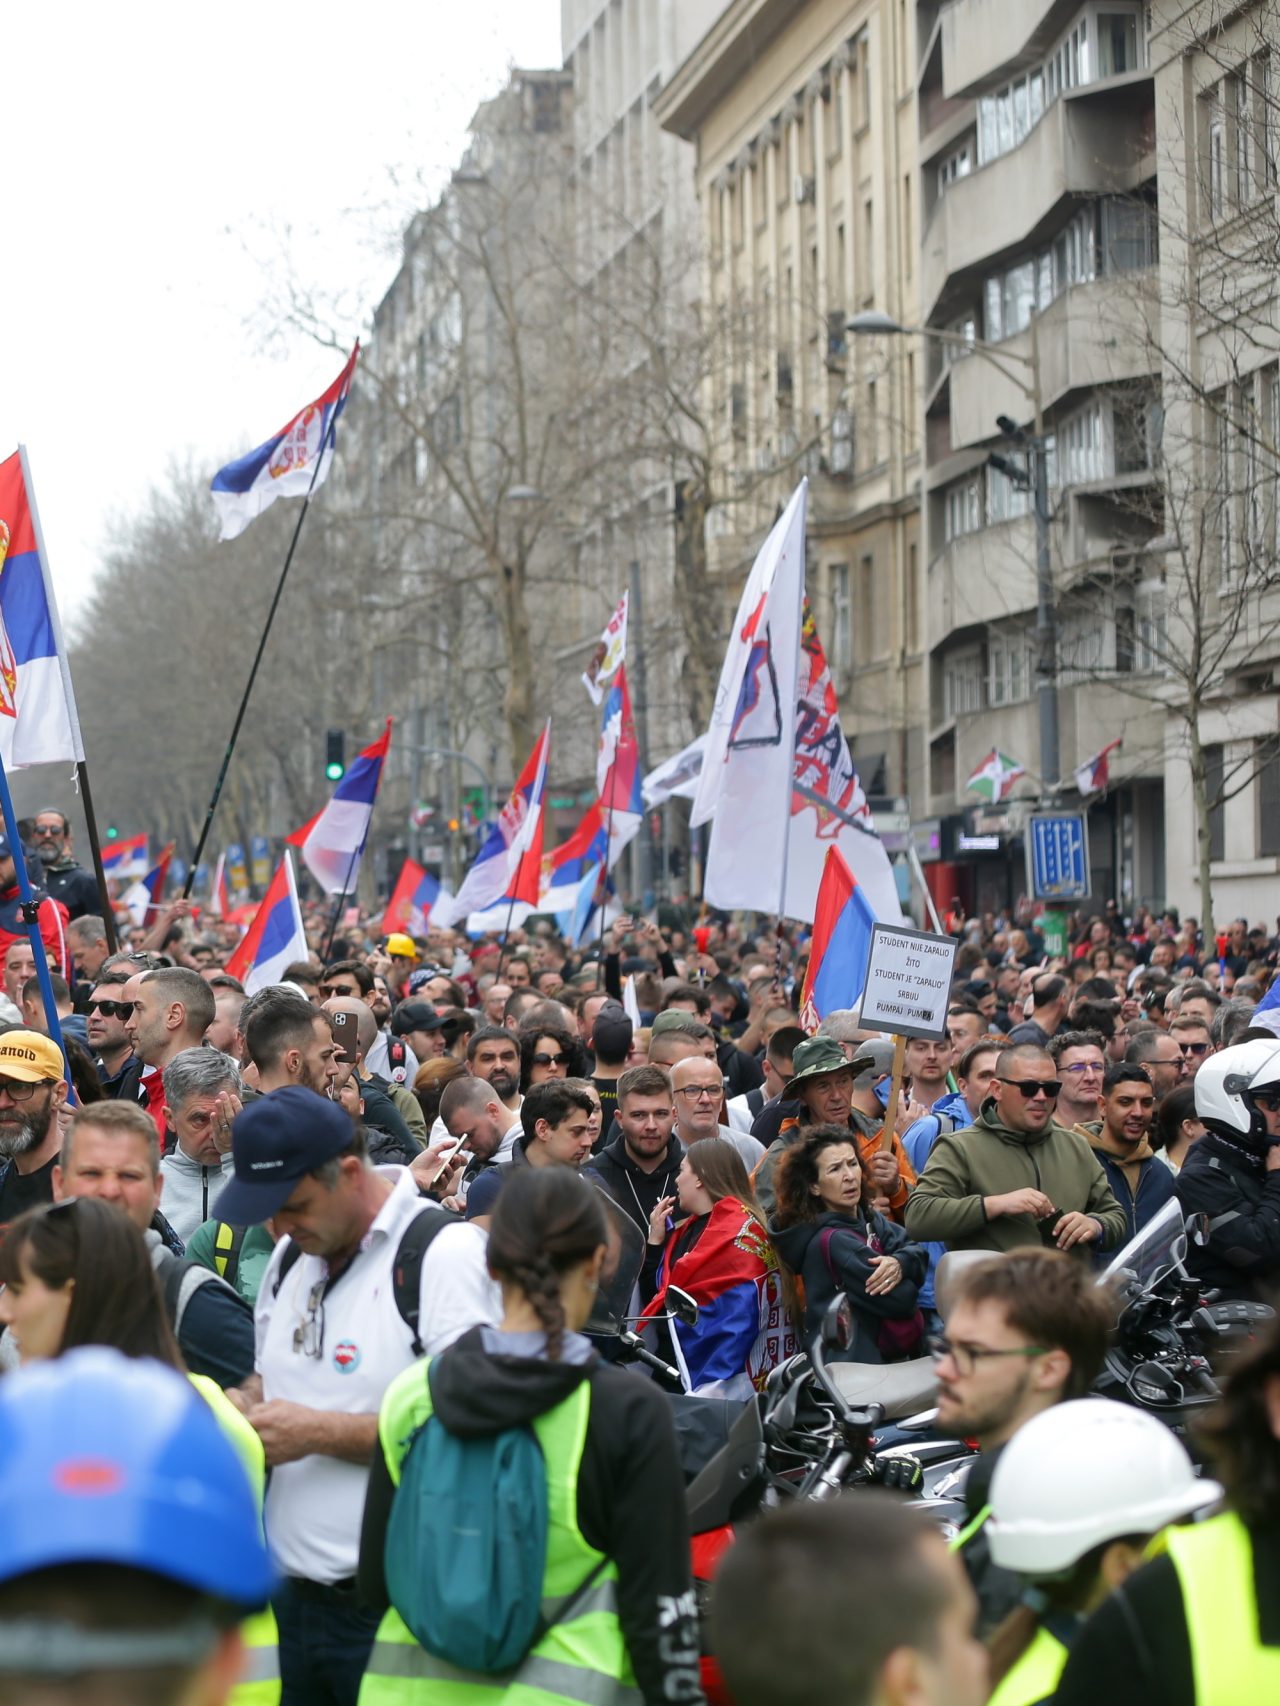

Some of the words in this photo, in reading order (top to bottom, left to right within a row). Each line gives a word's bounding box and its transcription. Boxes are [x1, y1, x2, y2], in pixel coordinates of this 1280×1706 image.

[879, 936, 908, 950] STUDENT
[910, 941, 924, 952] NIJE
[924, 945, 950, 957] ZAPALIO
[905, 955, 921, 968] ŽITO
[875, 968, 904, 981] STUDENT
[905, 975, 912, 984] JE
[898, 989, 920, 1001] SRBIJU
[876, 1002, 904, 1015] PUMPAJ
